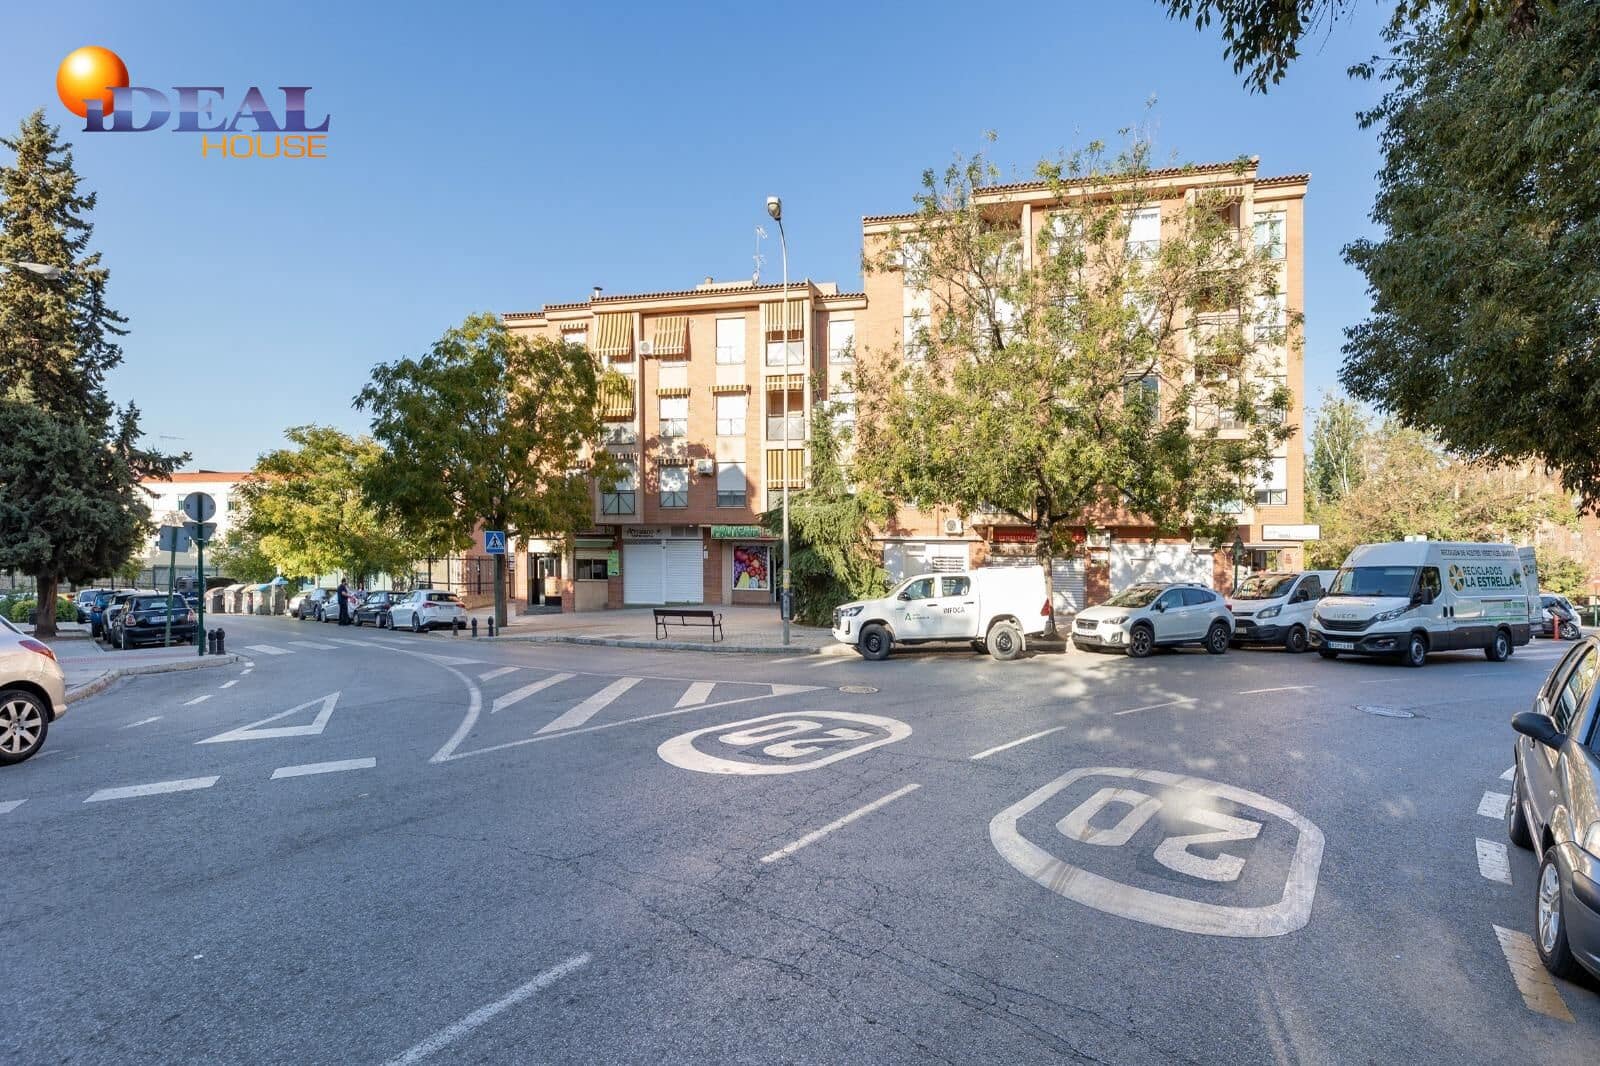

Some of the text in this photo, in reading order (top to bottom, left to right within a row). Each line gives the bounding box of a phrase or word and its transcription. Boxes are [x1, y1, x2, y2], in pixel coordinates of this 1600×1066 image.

[1463, 566, 1503, 576] RECICLADOS
[1465, 577, 1515, 587] LA ESTRELLA
[718, 720, 875, 758] 20
[1056, 787, 1263, 882] 20
